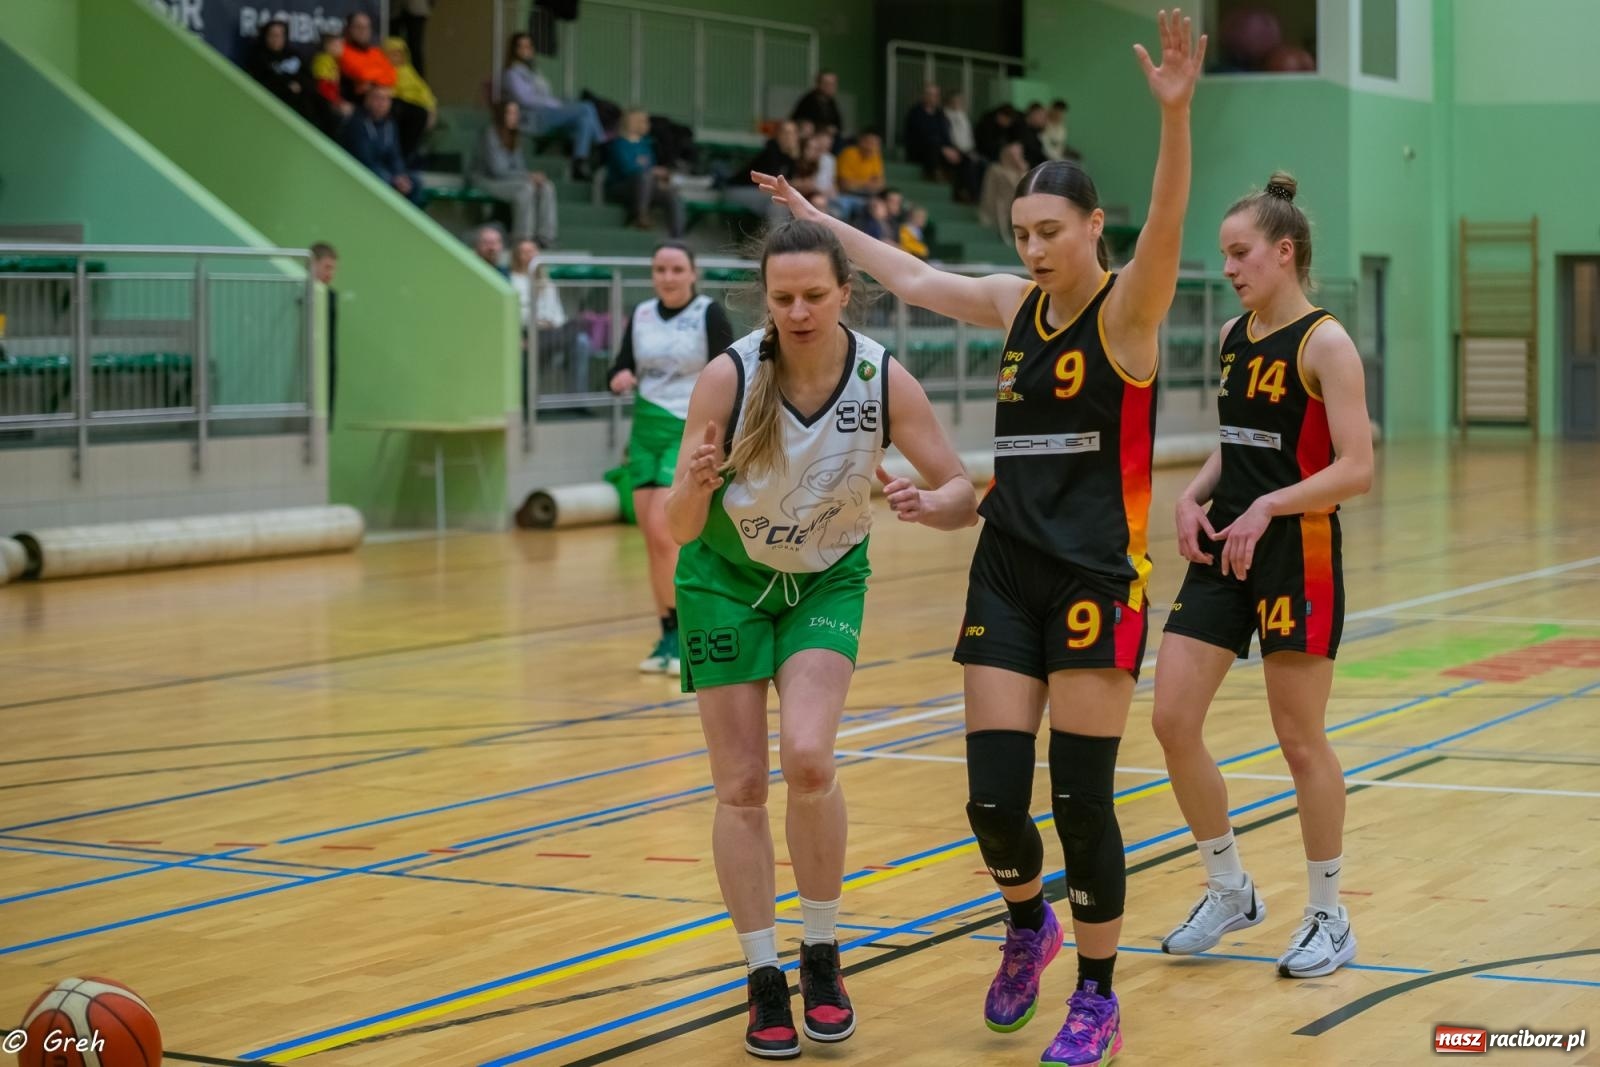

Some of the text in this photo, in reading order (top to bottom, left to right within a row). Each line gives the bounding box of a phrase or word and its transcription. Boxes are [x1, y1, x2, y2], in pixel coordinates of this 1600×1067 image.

[1054, 350, 1085, 399] 9
[1246, 355, 1287, 403] 14
[836, 400, 881, 433] 33
[995, 436, 1097, 450] ECHNET
[1066, 601, 1102, 649] 9
[1257, 596, 1296, 640] 14
[687, 627, 740, 666] 33
[997, 868, 1020, 879] NBA
